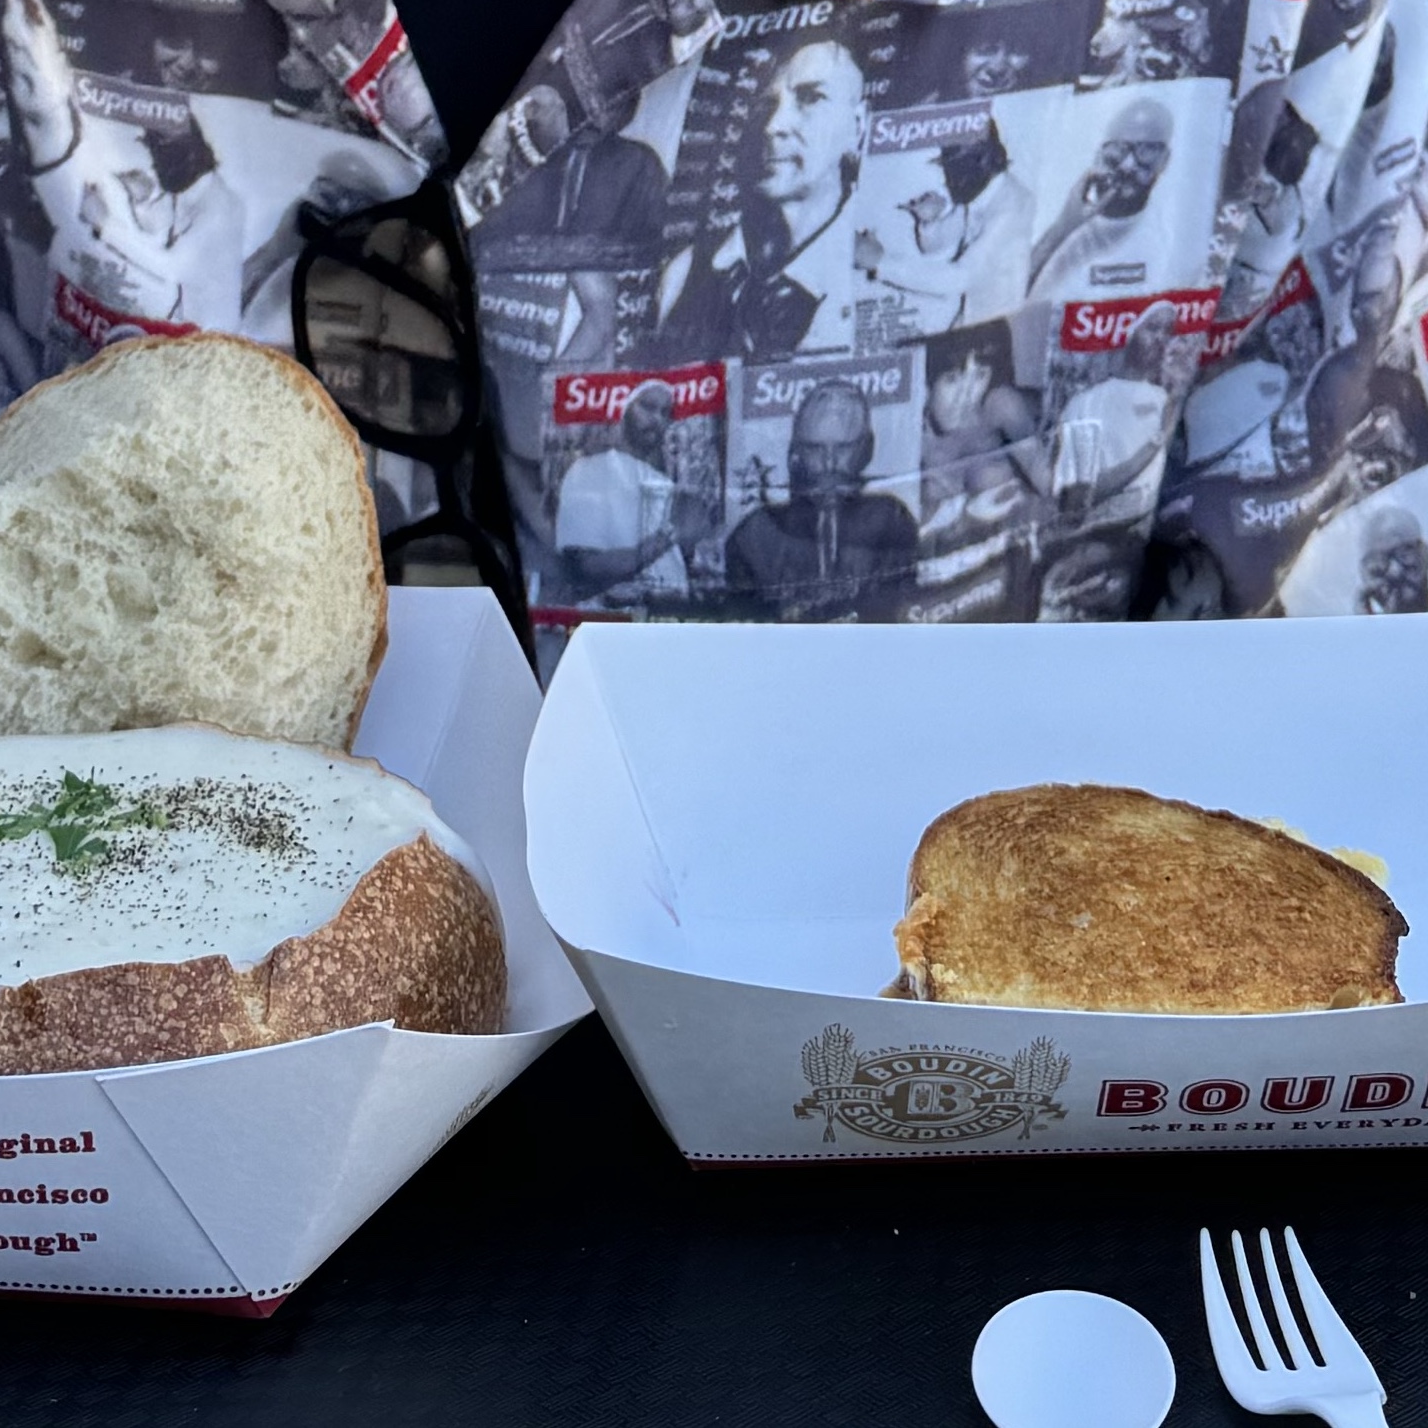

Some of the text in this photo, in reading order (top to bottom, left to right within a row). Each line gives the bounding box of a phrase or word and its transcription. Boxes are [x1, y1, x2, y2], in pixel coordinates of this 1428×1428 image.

[78, 77, 188, 122] Supreme
[875, 110, 987, 147] Supreme
[1072, 296, 1215, 344] Supme
[565, 375, 719, 418] Supme
[753, 366, 901, 411] Supme
[909, 1044, 1006, 1062] FRANCISCO
[866, 1058, 1008, 1085] BOUDIN
[818, 1088, 1044, 1103] SINCE 1849
[843, 1106, 1019, 1139] SOURDOUGH
[1167, 1121, 1276, 1132] FRESH
